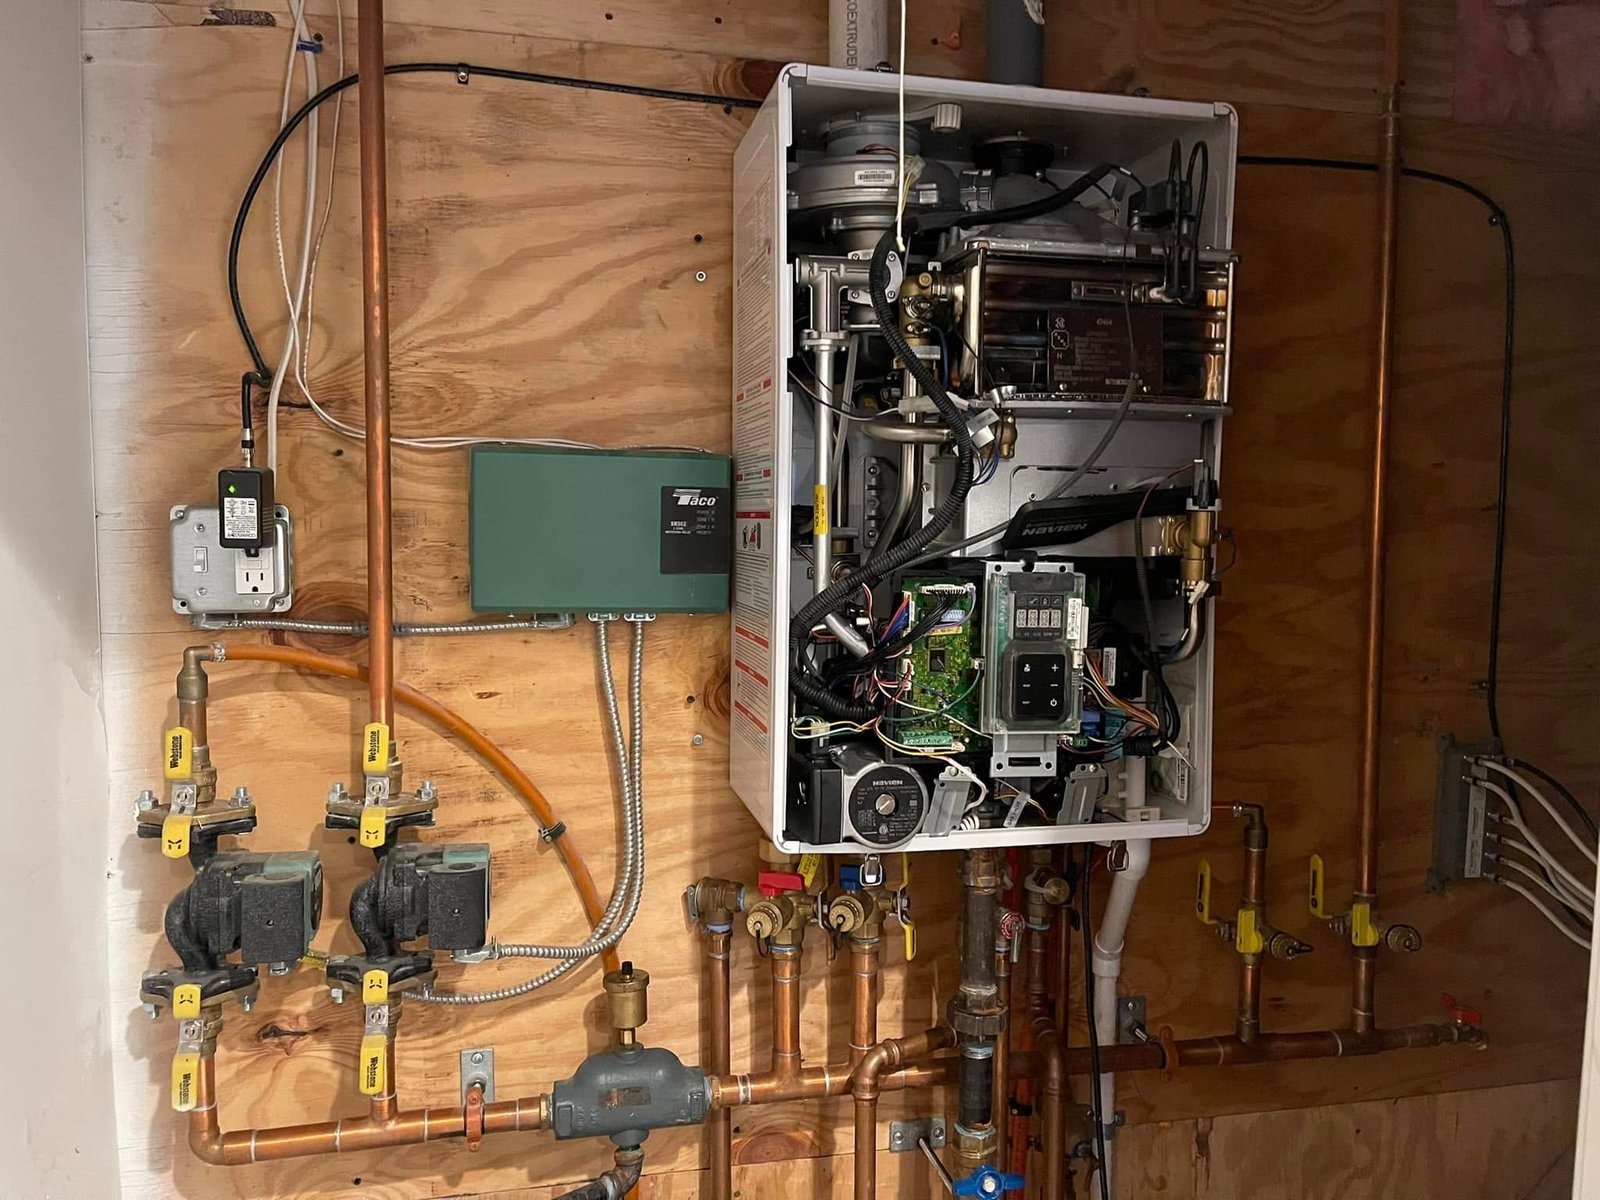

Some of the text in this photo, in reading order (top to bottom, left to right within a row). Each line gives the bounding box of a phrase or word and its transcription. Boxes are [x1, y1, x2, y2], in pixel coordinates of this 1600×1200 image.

[847, 0, 857, 67] OEXTRUDE
[672, 489, 716, 506] Taco
[170, 736, 178, 768] Webstone
[368, 731, 376, 762] Webstone
[370, 1056, 378, 1087] Webstone
[183, 1072, 191, 1104] Webstone
